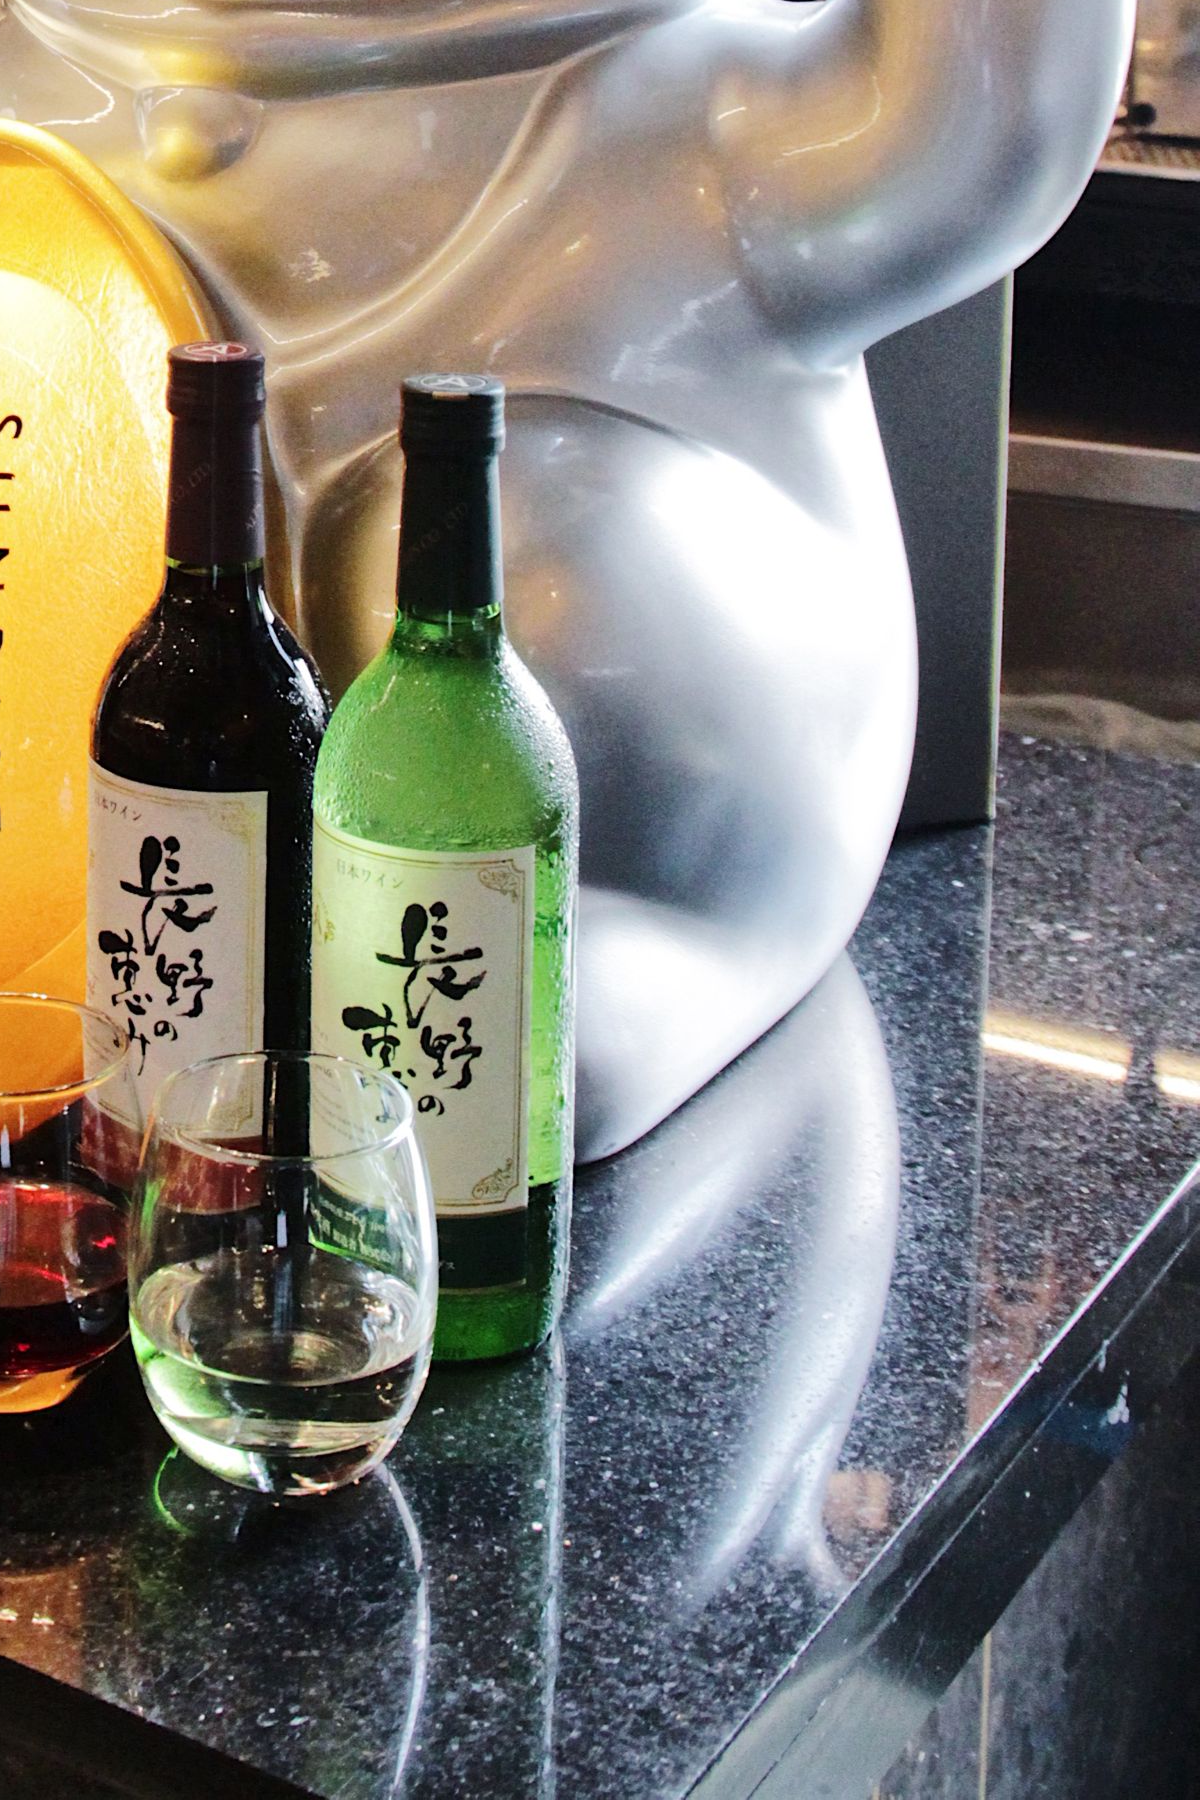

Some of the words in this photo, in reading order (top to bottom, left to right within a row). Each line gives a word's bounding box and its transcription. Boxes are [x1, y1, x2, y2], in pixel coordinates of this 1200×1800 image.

[336, 859, 404, 889] 日本ワイン
